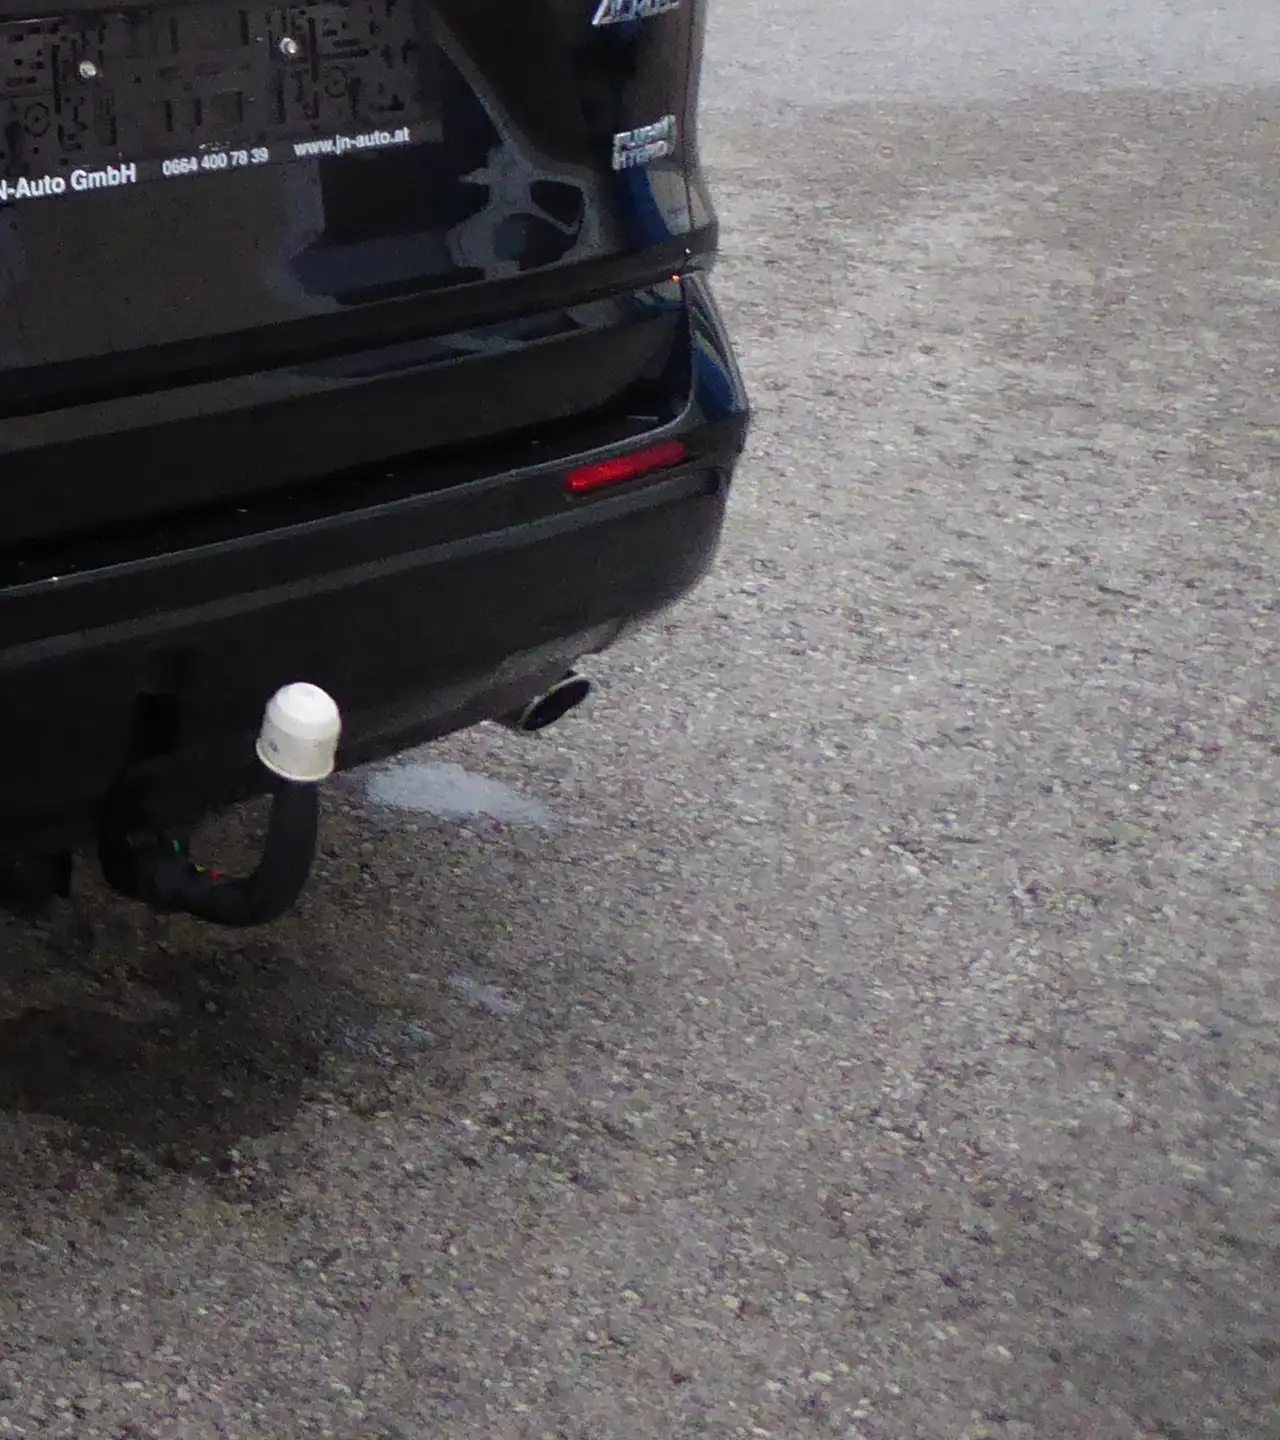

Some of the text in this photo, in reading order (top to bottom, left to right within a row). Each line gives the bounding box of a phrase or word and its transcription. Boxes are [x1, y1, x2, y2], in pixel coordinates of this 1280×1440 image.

[70, 162, 137, 192] GmbH
[201, 152, 228, 170] 400
[292, 127, 411, 156] www.jn-auto.at
